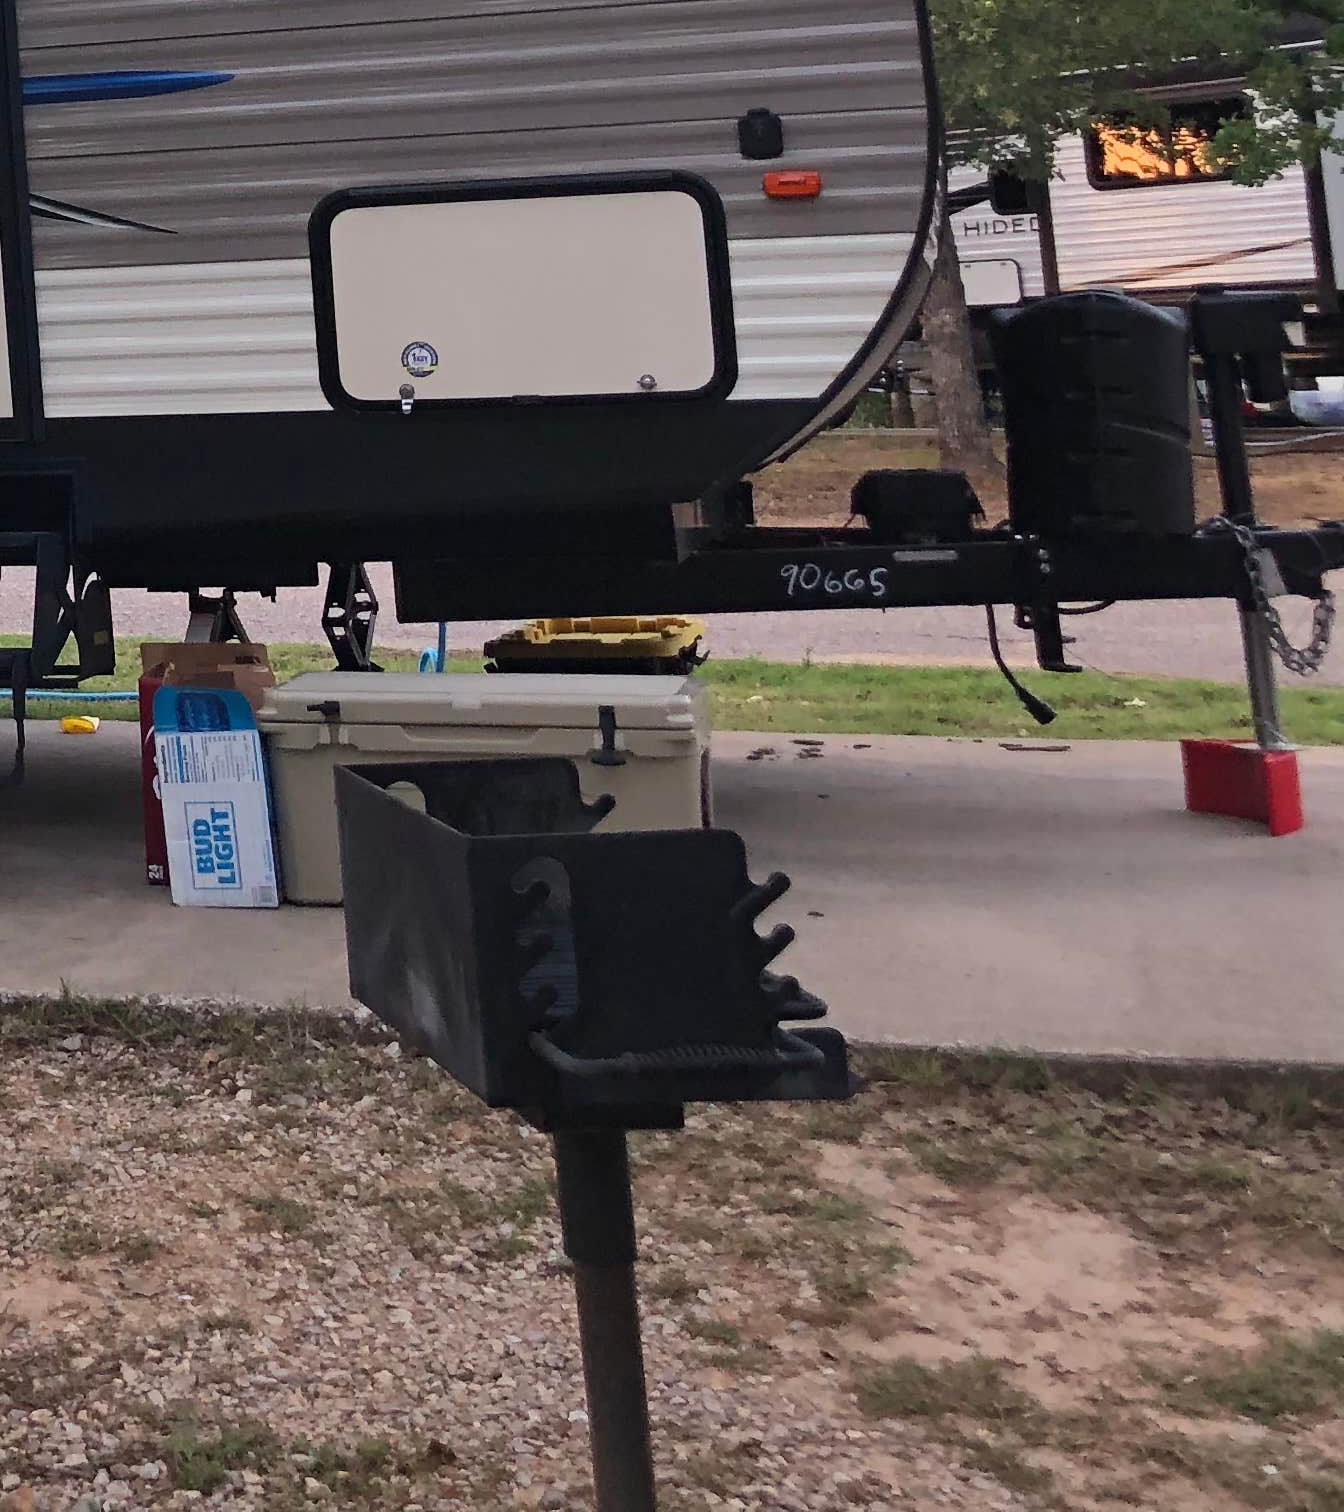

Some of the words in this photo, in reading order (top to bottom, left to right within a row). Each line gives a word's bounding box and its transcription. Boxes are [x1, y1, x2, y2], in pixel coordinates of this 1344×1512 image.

[780, 563, 889, 597] 90665
[193, 818, 216, 874] BUD
[210, 807, 237, 884] LIGHT
[148, 864, 160, 880] 24
